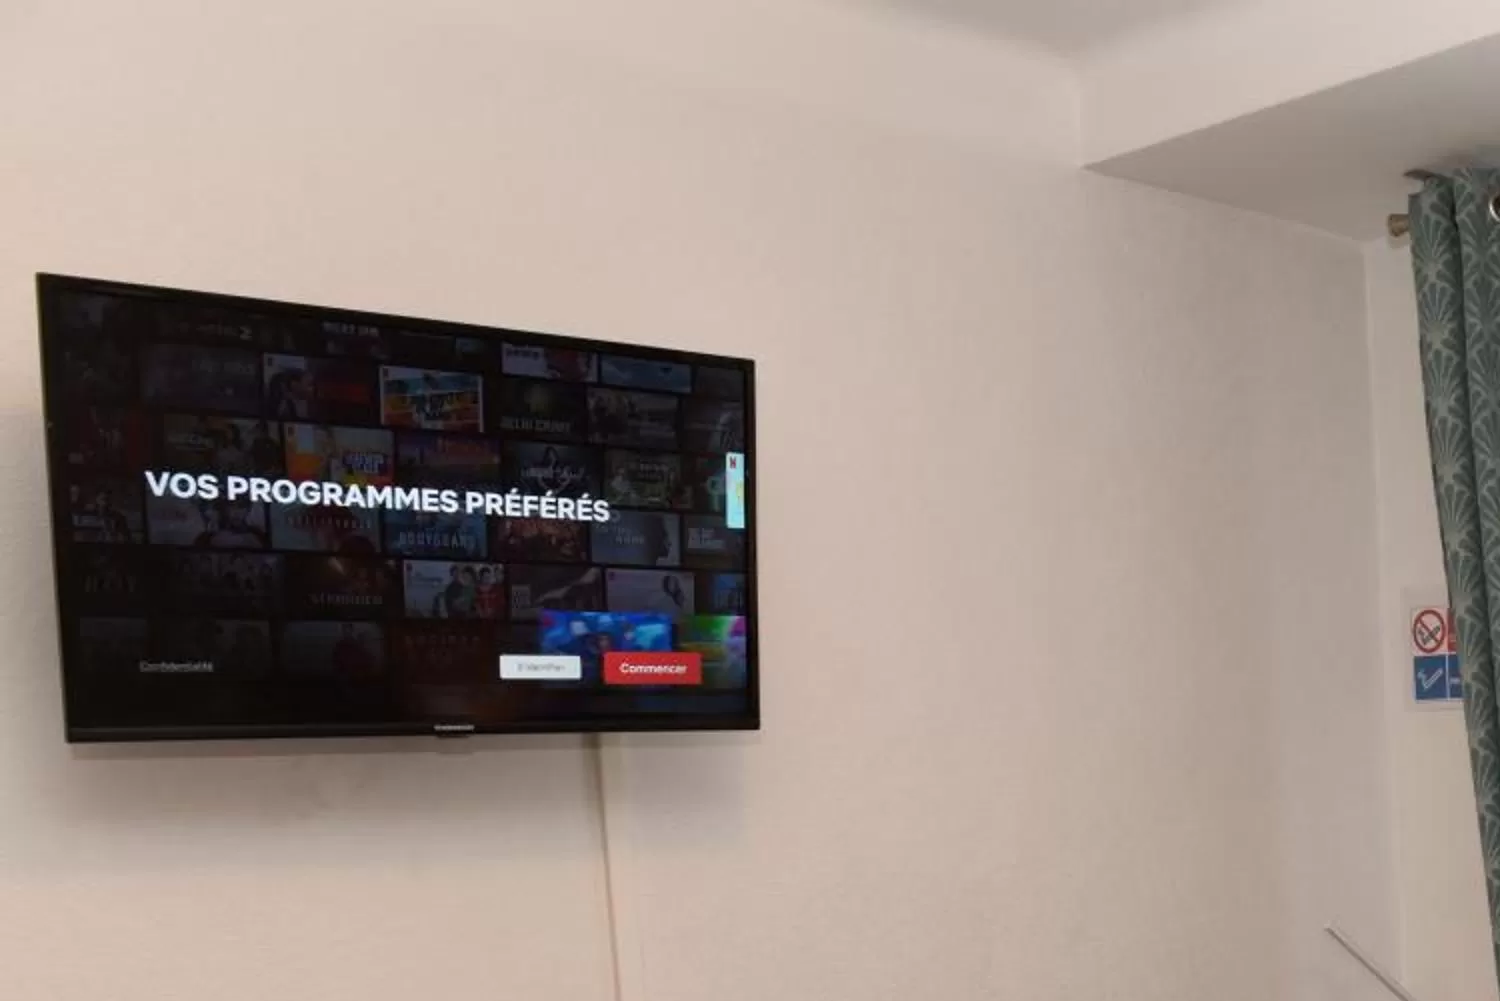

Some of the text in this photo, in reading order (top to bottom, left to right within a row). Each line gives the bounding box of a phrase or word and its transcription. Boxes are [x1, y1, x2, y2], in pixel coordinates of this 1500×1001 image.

[145, 470, 611, 523] VOS PROGRAMMES PRÉFÉRÉS
[619, 662, 687, 674] Commencer
